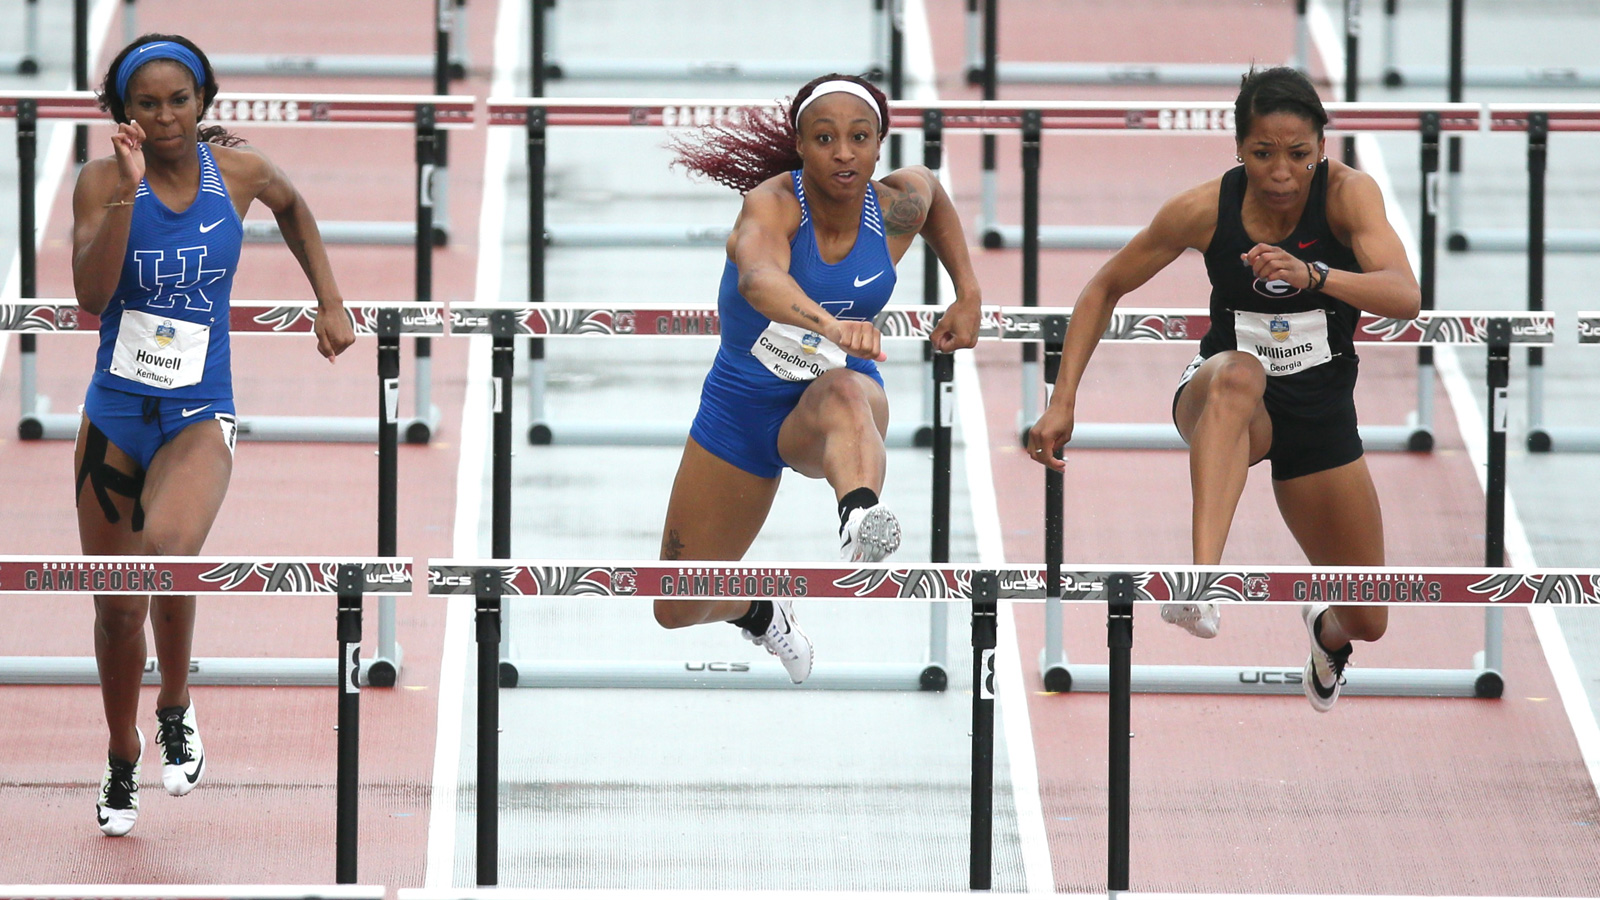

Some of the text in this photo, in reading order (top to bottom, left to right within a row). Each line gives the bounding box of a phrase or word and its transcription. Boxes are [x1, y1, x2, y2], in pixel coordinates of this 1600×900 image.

[657, 317, 720, 335] GAME
[1582, 325, 1600, 336] UC
[759, 336, 829, 377] Camacho-Qu
[1254, 342, 1313, 359] Williams
[136, 349, 182, 371] Howell
[1270, 360, 1302, 372] Georgia
[136, 367, 174, 386] Kentucky
[25, 570, 173, 591] GAMECOCKS
[433, 576, 471, 586] UCS
[661, 575, 808, 597] GAMECOCKS
[1065, 581, 1104, 591] UCS
[1293, 580, 1441, 602] GAMECOCKS
[144, 661, 200, 673] US
[686, 662, 750, 672] UCS
[1240, 672, 1303, 684] UCS
